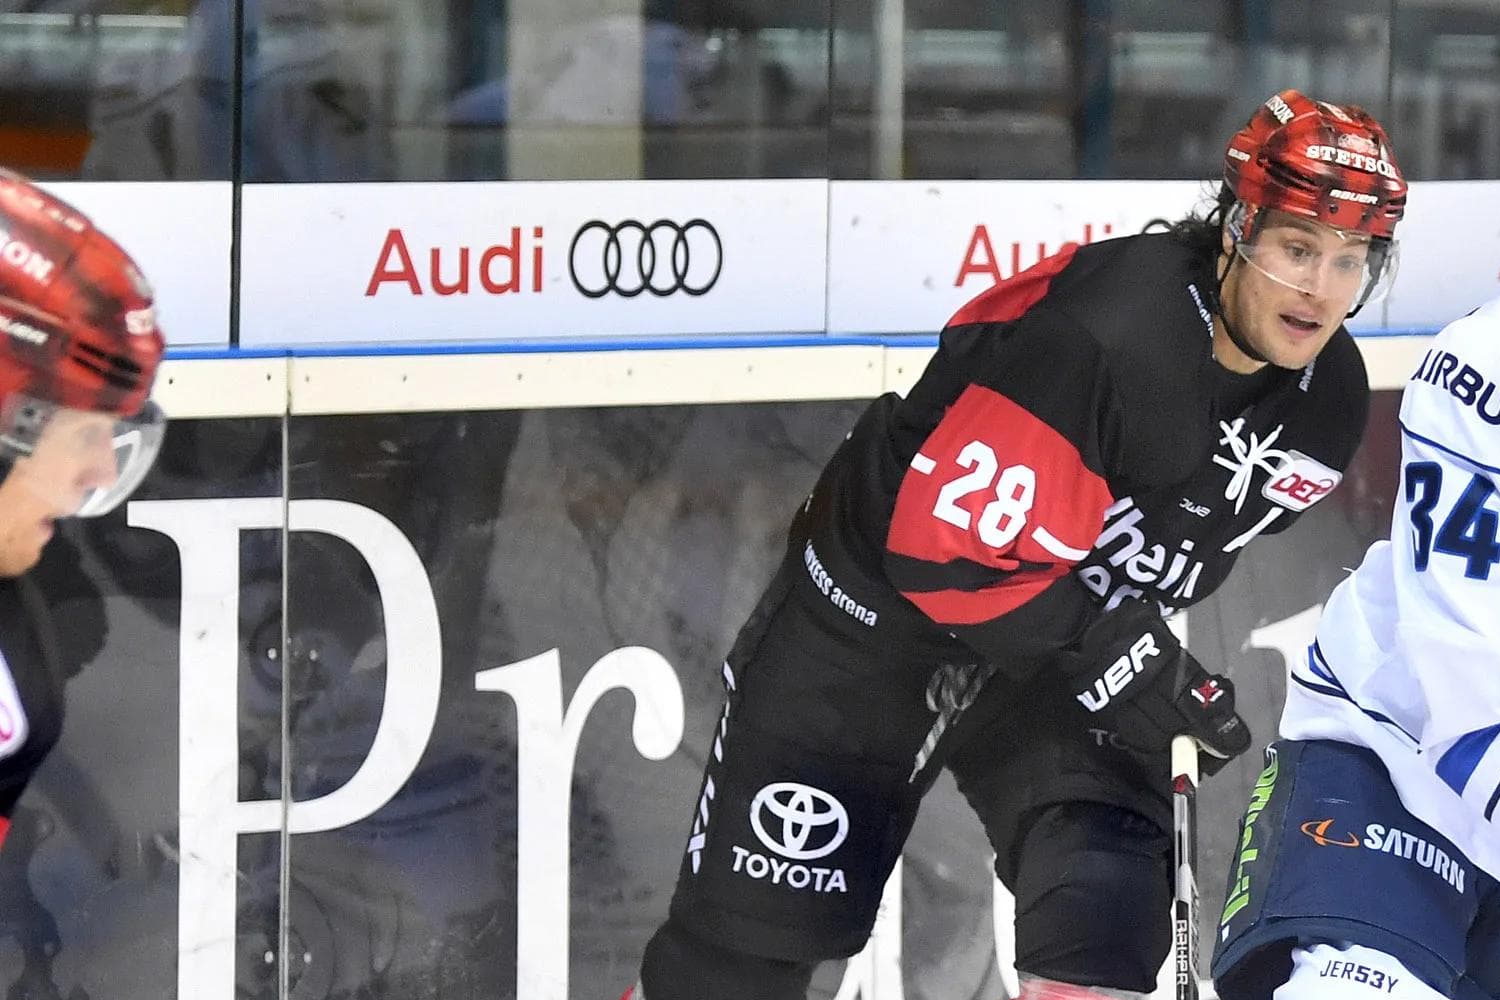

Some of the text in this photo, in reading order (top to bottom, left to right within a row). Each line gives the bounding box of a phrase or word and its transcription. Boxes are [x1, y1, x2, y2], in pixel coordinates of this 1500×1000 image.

[365, 226, 545, 297] Audi
[932, 440, 1037, 550] 28
[830, 586, 878, 627] arena
[731, 845, 848, 893] TOYOTA
[1362, 823, 1465, 894] SATURN
[1319, 959, 1399, 994] JER53Y
